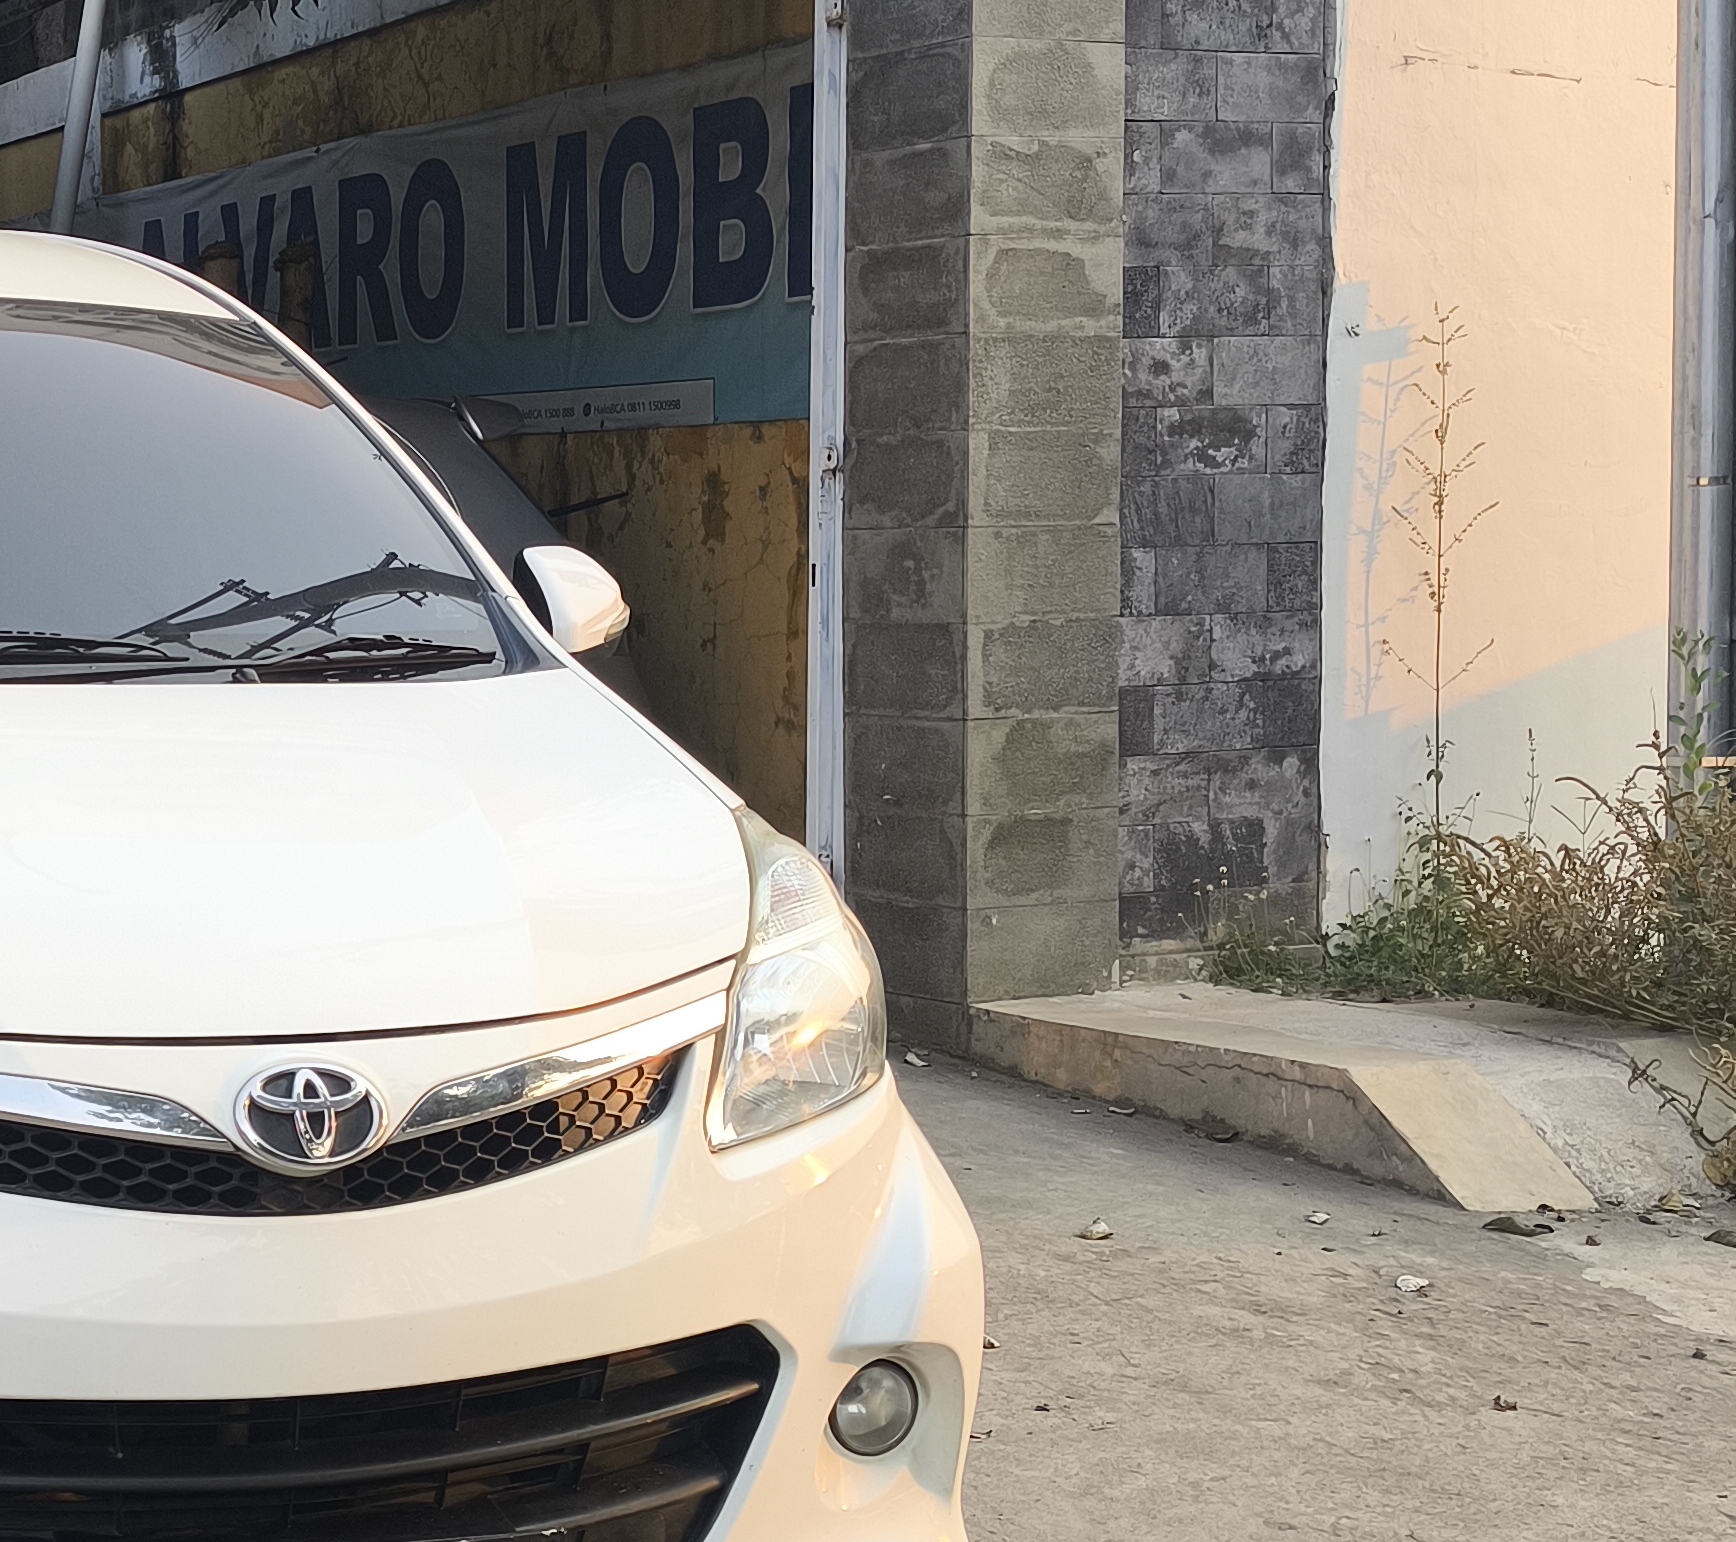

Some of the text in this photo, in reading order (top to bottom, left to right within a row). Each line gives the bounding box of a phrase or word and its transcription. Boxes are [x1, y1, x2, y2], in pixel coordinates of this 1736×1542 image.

[140, 83, 814, 349] VARO MOBI
[628, 401, 646, 413] 0811
